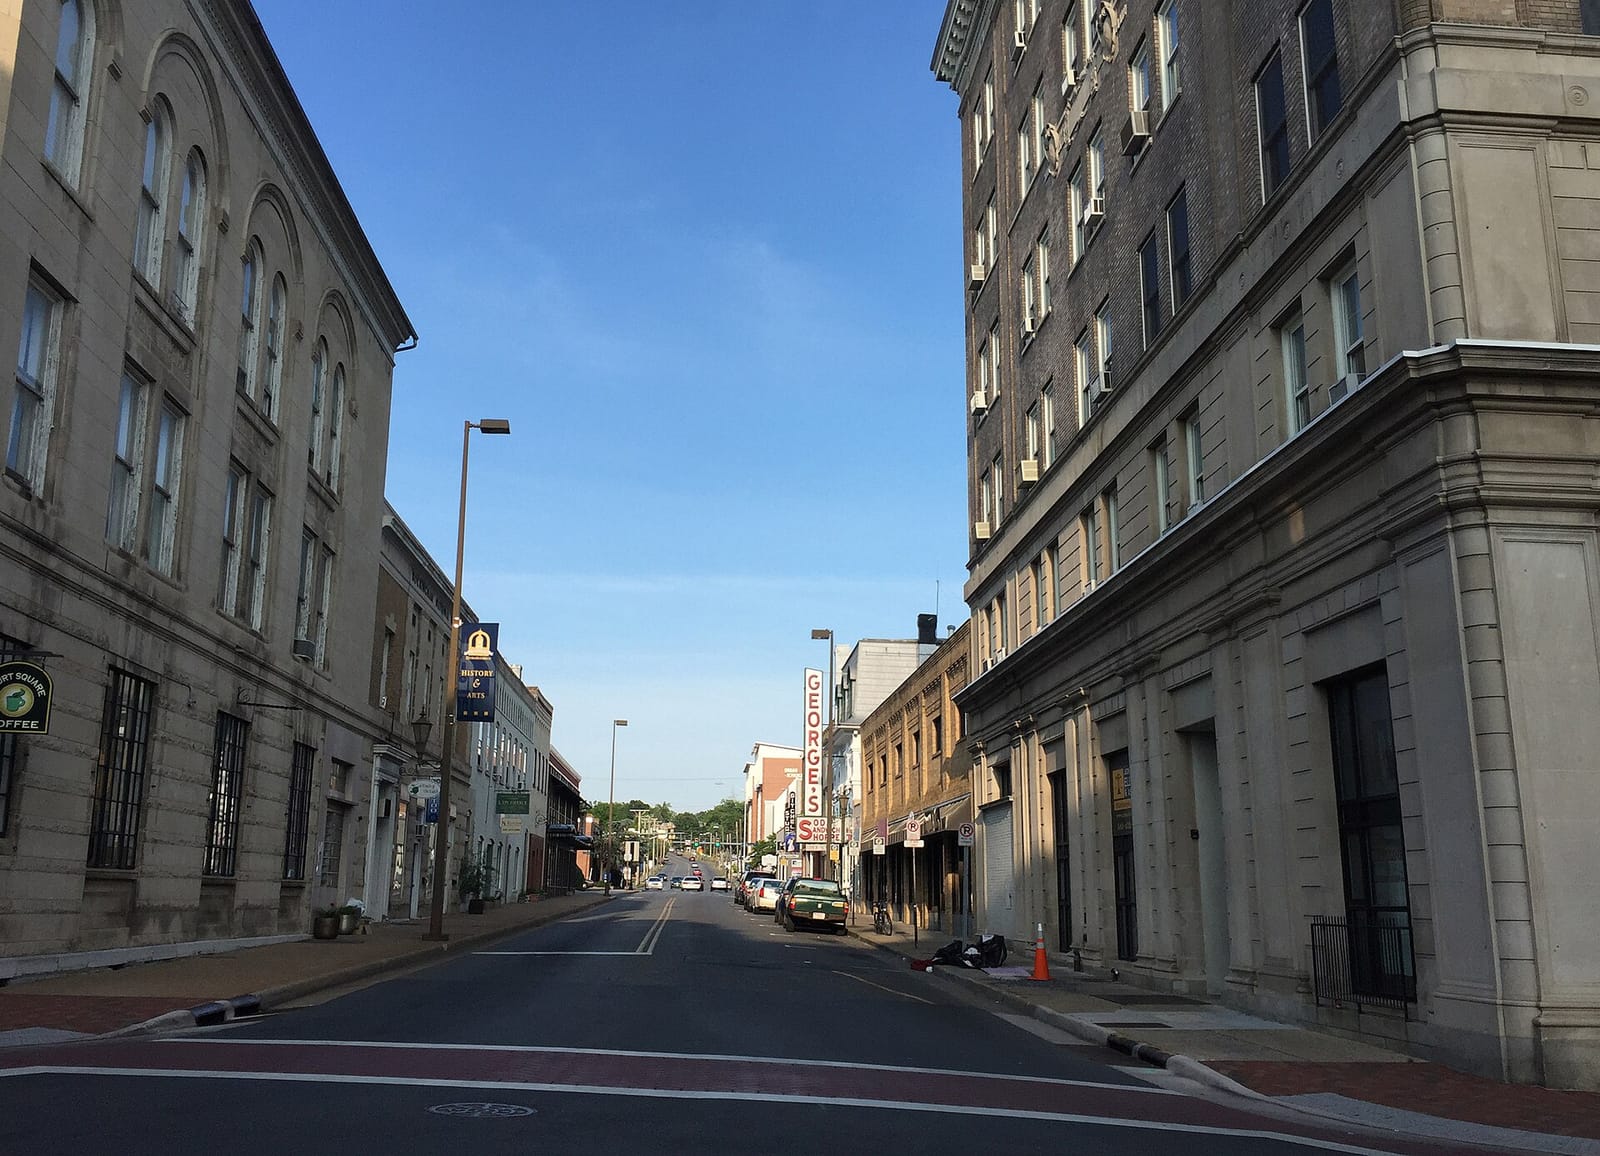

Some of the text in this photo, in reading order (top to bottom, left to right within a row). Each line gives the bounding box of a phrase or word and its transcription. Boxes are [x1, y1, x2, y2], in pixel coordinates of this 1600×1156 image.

[461, 669, 493, 677] HISTORY
[15, 672, 47, 697] SQUARE
[472, 678, 481, 688] &
[807, 674, 820, 813] GEORGE'S
